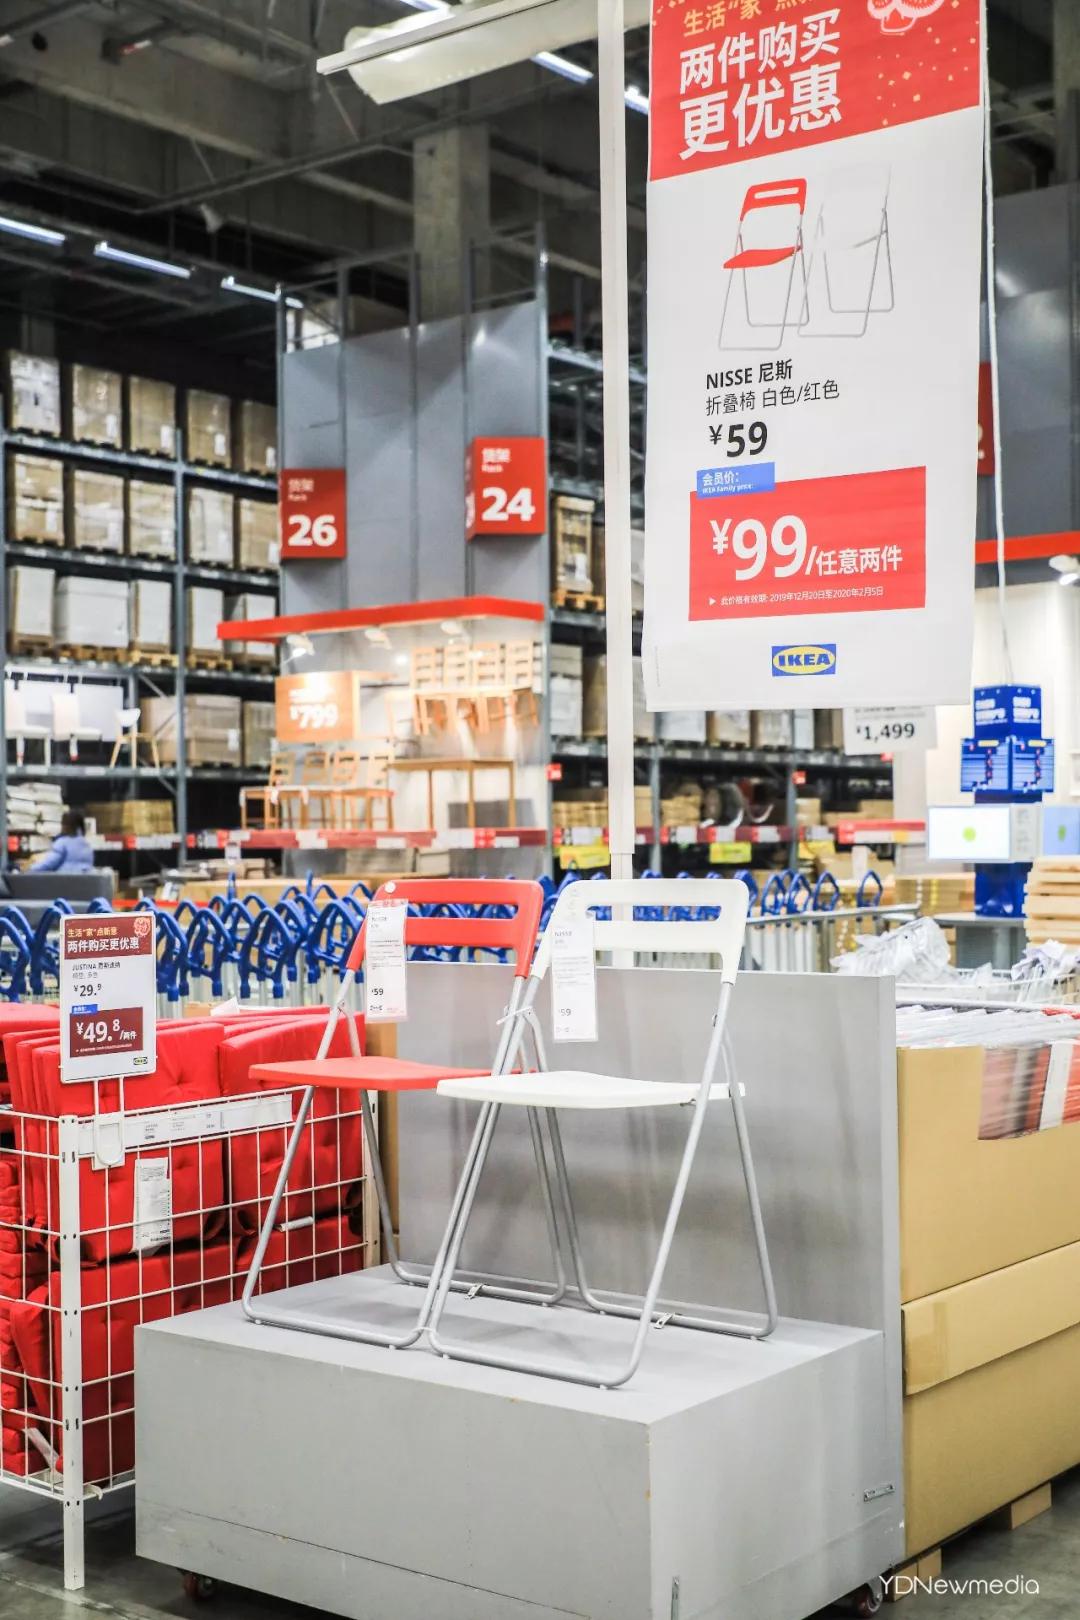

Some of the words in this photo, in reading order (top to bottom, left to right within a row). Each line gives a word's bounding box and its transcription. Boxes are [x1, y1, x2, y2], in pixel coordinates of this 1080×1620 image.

[680, 8, 841, 95] 两件购买
[679, 61, 842, 160] 更优惠
[706, 367, 753, 390] NISSE
[758, 358, 793, 384] 尼斯
[706, 390, 756, 416] 折叠椅
[762, 379, 840, 408] 白色/红色
[709, 421, 768, 458] ¥59
[482, 486, 536, 521] 24
[288, 514, 338, 547] 26
[778, 653, 831, 667] IKEA
[67, 936, 139, 953] 两件购买更优惠
[73, 983, 102, 997] ¥29.9
